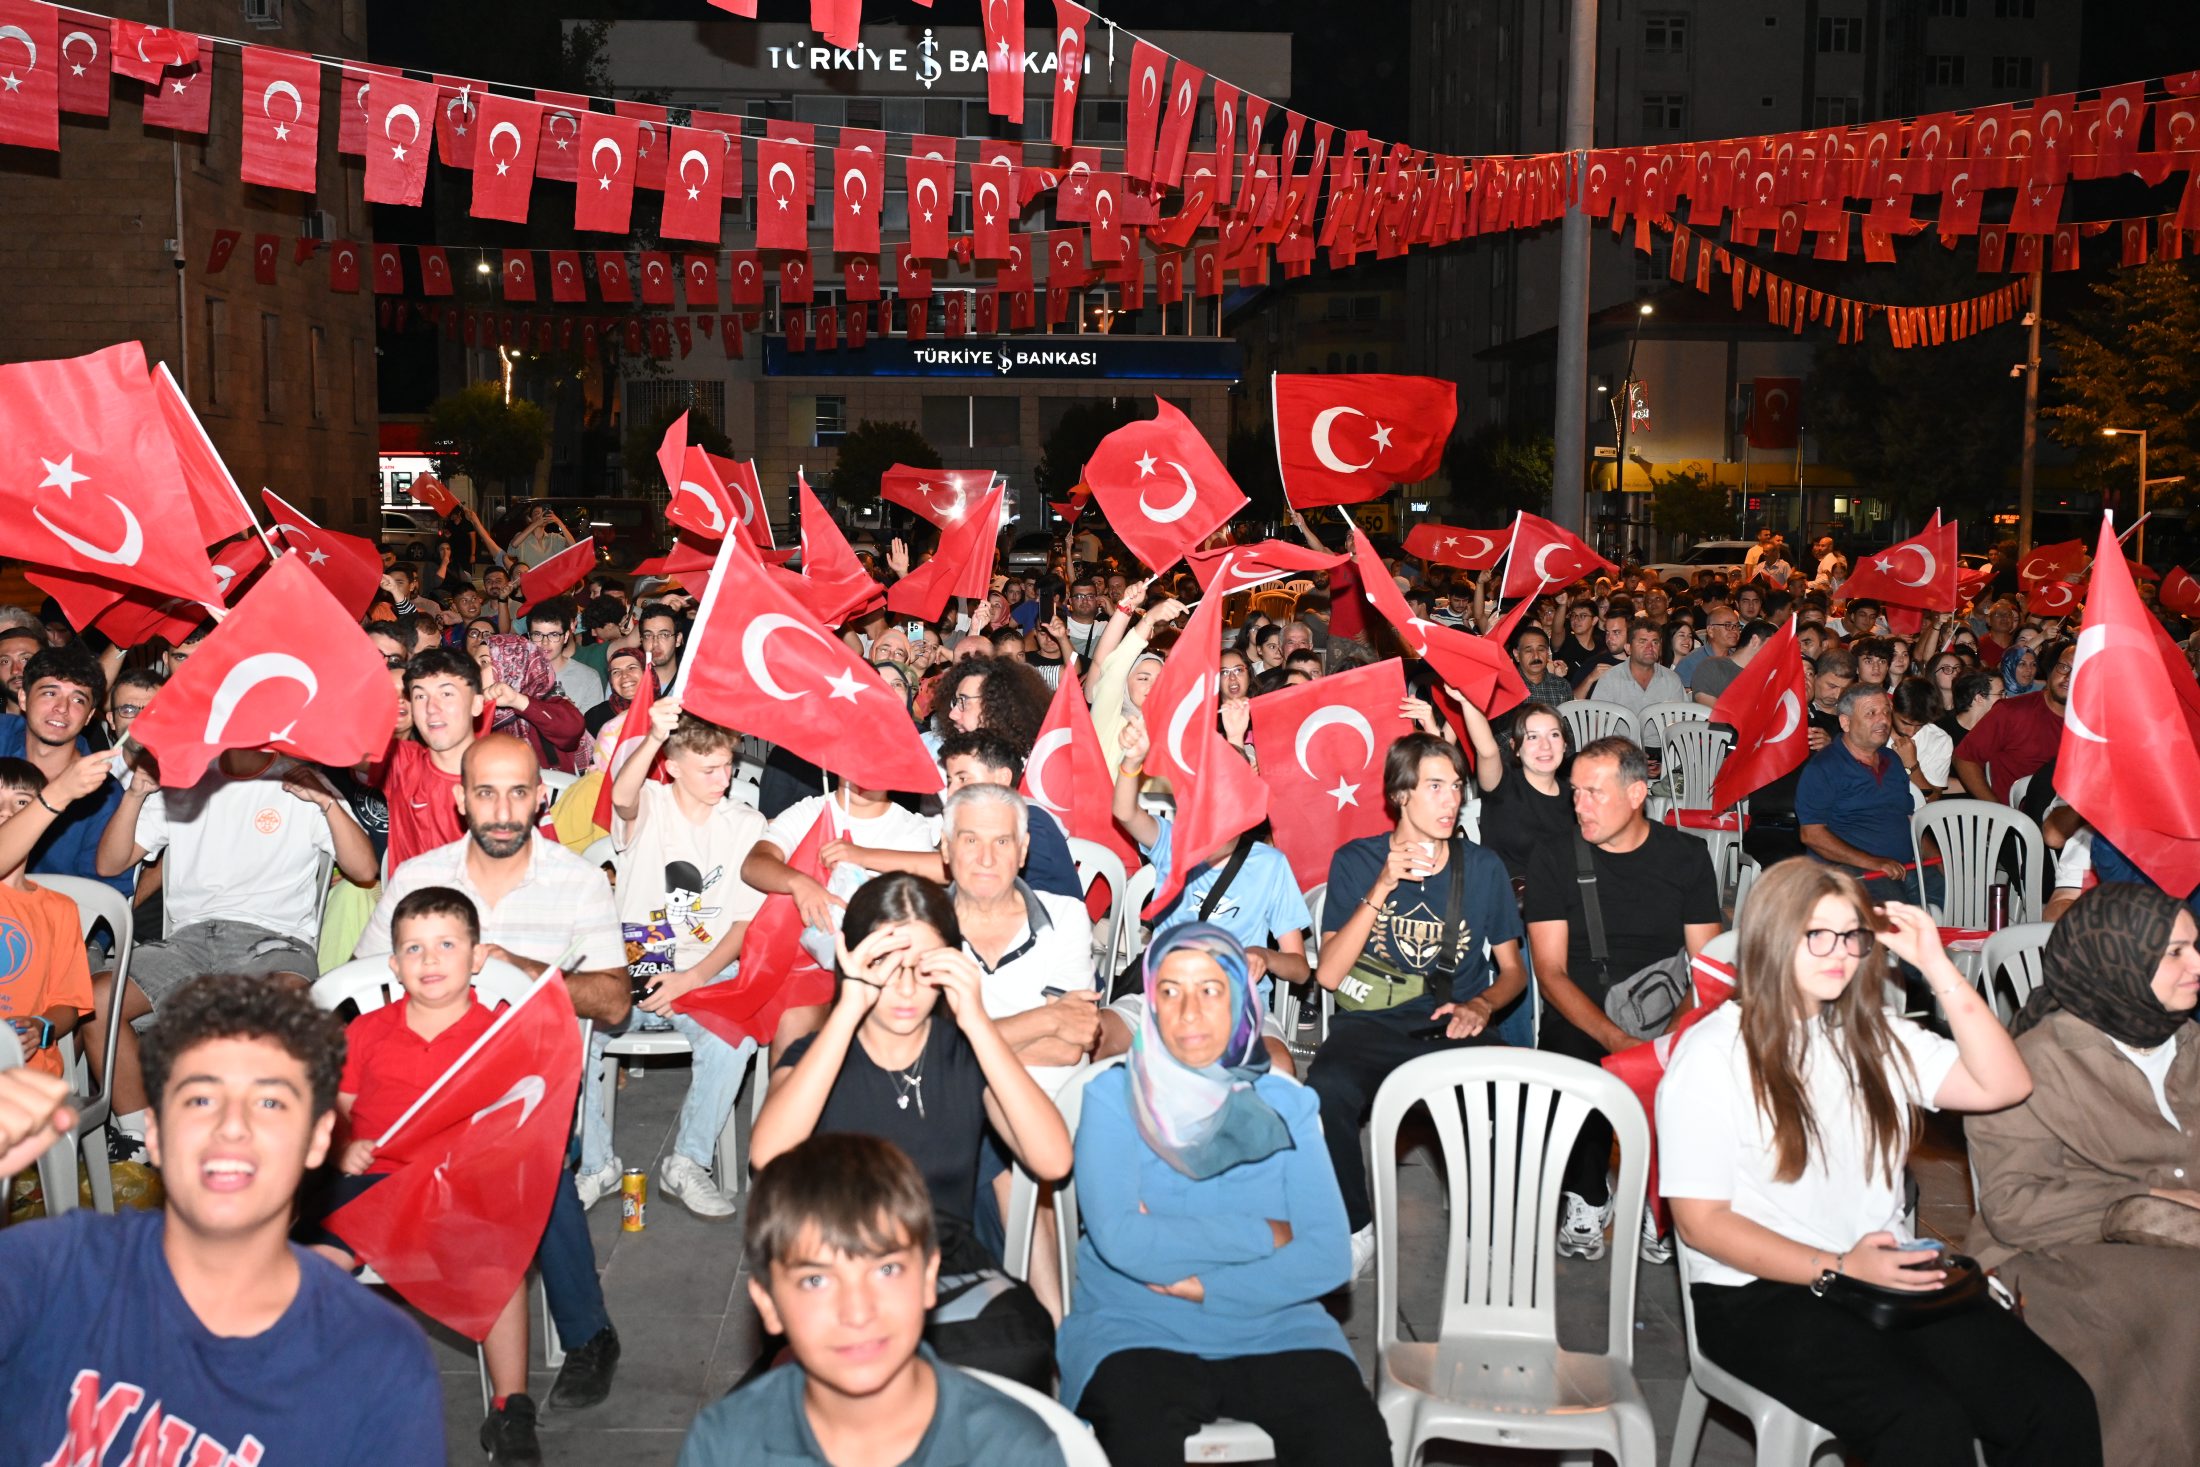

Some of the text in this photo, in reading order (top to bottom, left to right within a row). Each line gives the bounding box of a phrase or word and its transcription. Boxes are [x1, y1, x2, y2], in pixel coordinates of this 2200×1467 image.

[766, 41, 908, 71] TÜRKİYE
[949, 50, 1091, 74] BAKAI
[913, 347, 993, 364] TÜRKİYE
[1016, 351, 1097, 365] BANKASI
[1337, 975, 1374, 1005] IKE
